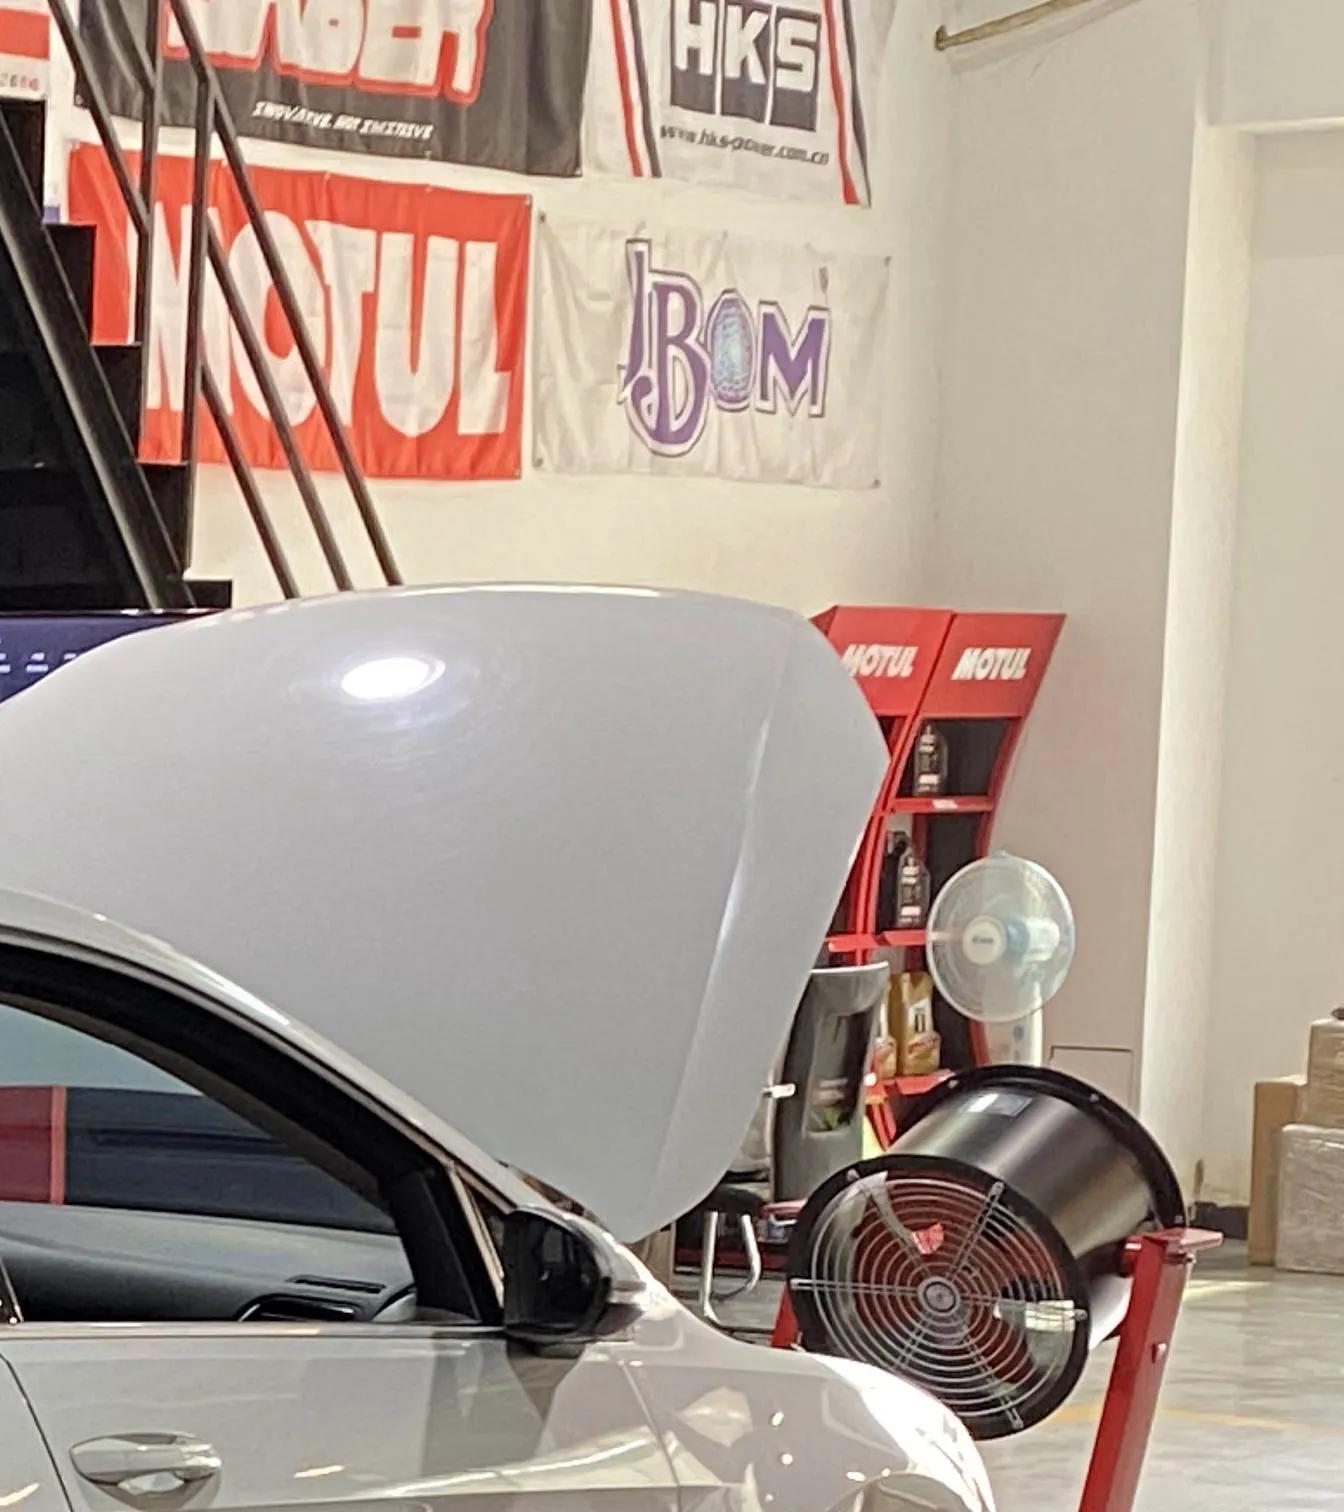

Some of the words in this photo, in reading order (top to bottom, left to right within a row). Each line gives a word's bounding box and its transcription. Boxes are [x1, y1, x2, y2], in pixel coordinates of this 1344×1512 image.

[673, 0, 817, 92] HKS
[127, 197, 512, 438] MOTUL
[839, 644, 919, 678] MOTUL
[951, 647, 1032, 681] MOTUL
